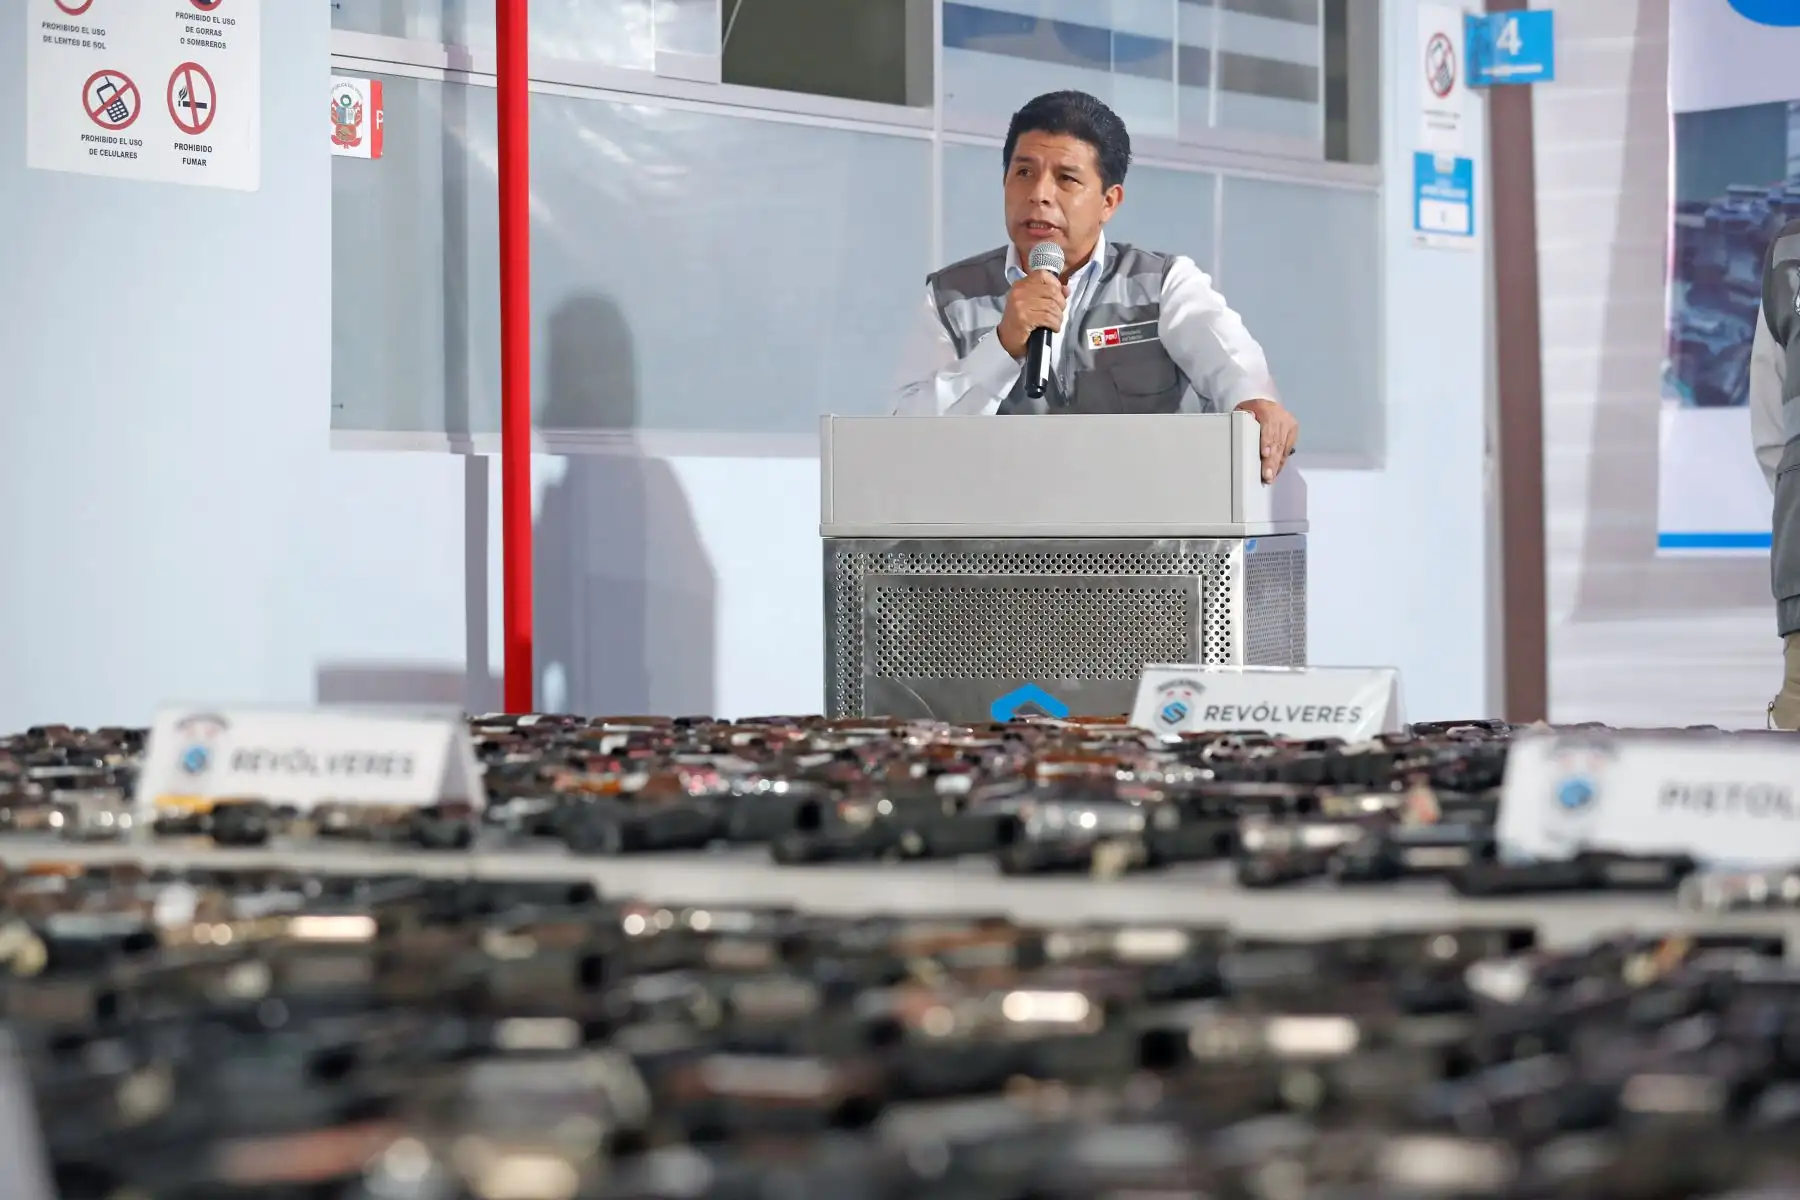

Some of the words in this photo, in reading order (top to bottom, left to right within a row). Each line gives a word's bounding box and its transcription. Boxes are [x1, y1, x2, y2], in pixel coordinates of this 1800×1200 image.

[175, 11, 211, 23] PROHIBIDO
[212, 16, 221, 24] EL
[222, 17, 236, 26] USO
[42, 21, 80, 33] PROHIBIDO
[81, 26, 90, 35] EL
[91, 27, 106, 36] USO
[185, 26, 195, 34] DE
[195, 27, 223, 37] GORRAS
[43, 35, 53, 43] DE
[54, 36, 80, 47] LENTES
[82, 39, 91, 48] DE
[92, 41, 107, 50] SOL
[186, 38, 227, 49] SOMBREROS
[1496, 17, 1524, 56] 4
[81, 133, 118, 144] PROHIBIDO
[119, 137, 128, 146] EL
[129, 138, 143, 147] USO
[89, 148, 98, 156] DE
[99, 149, 138, 159] CELULARES
[174, 142, 213, 153] PROHIBIDO
[182, 157, 207, 167] FUMAR
[1204, 701, 1362, 723] REVÓLVERES
